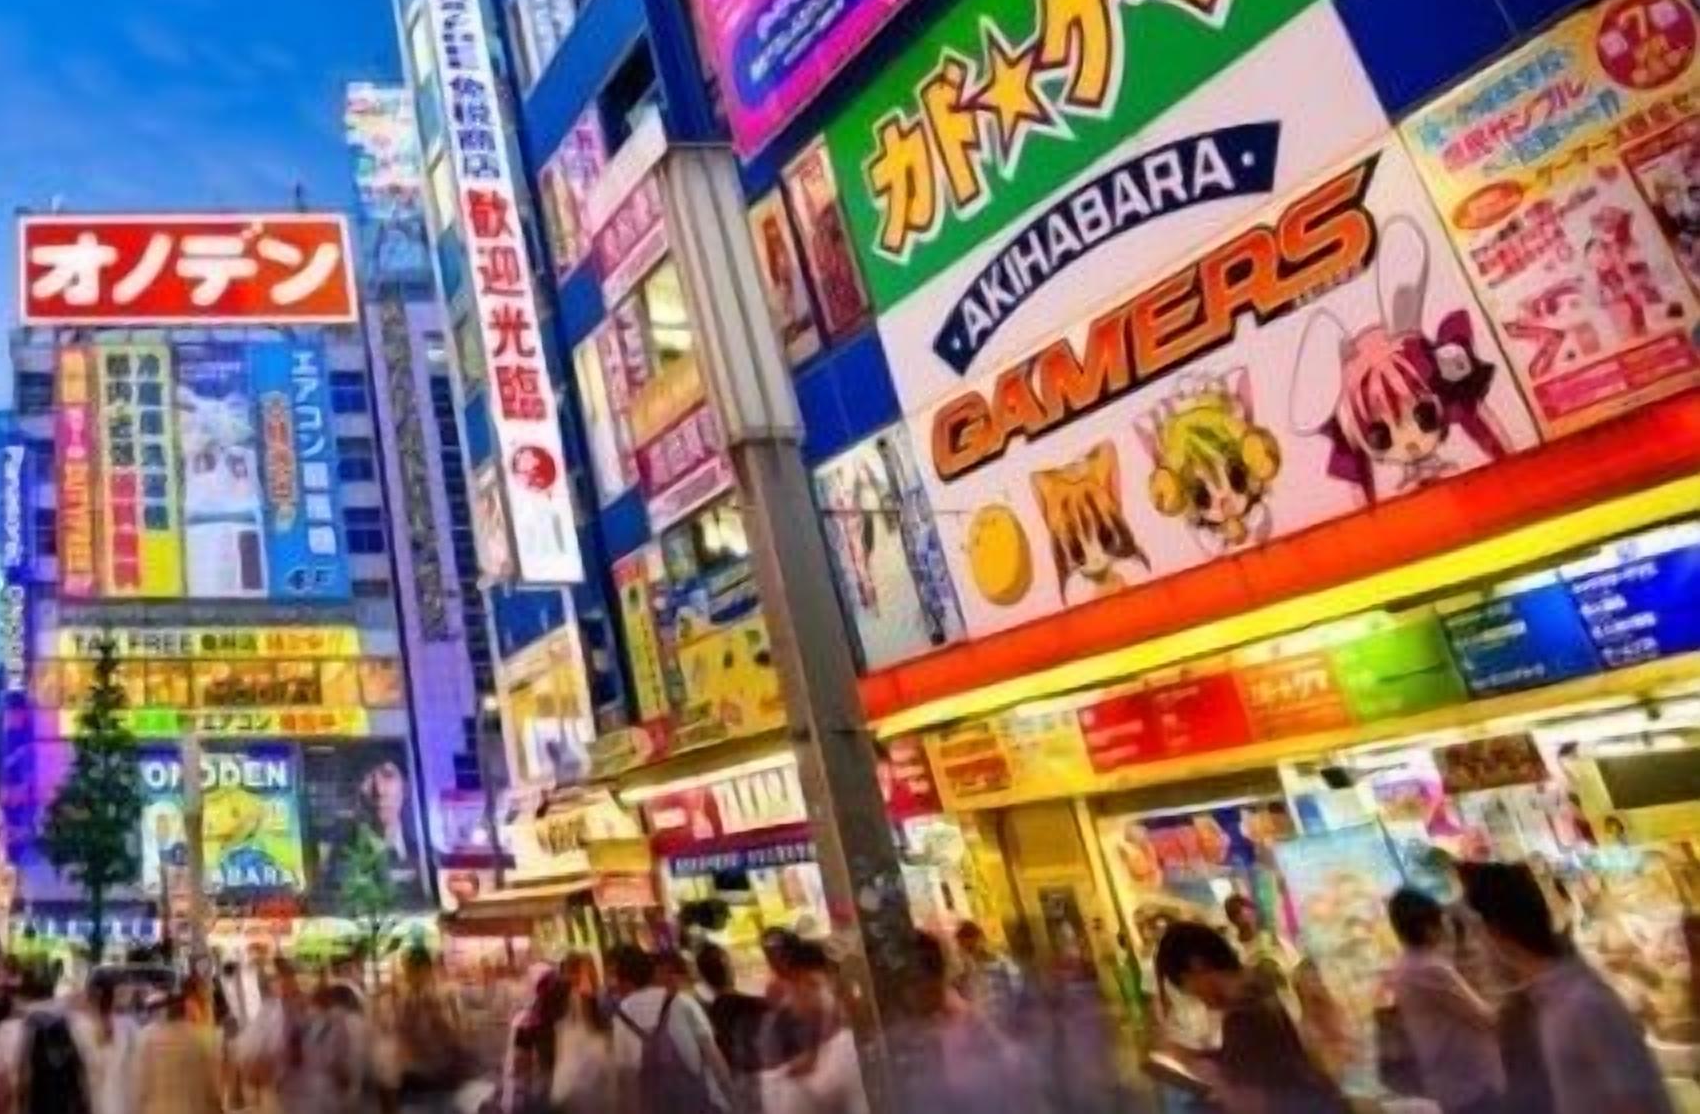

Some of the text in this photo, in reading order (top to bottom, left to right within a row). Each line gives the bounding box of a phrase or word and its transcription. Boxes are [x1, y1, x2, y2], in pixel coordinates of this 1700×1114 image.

[31, 221, 339, 307] オノデン
[931, 152, 1384, 483] GAMERS
[963, 137, 1238, 349] AKIHABARA
